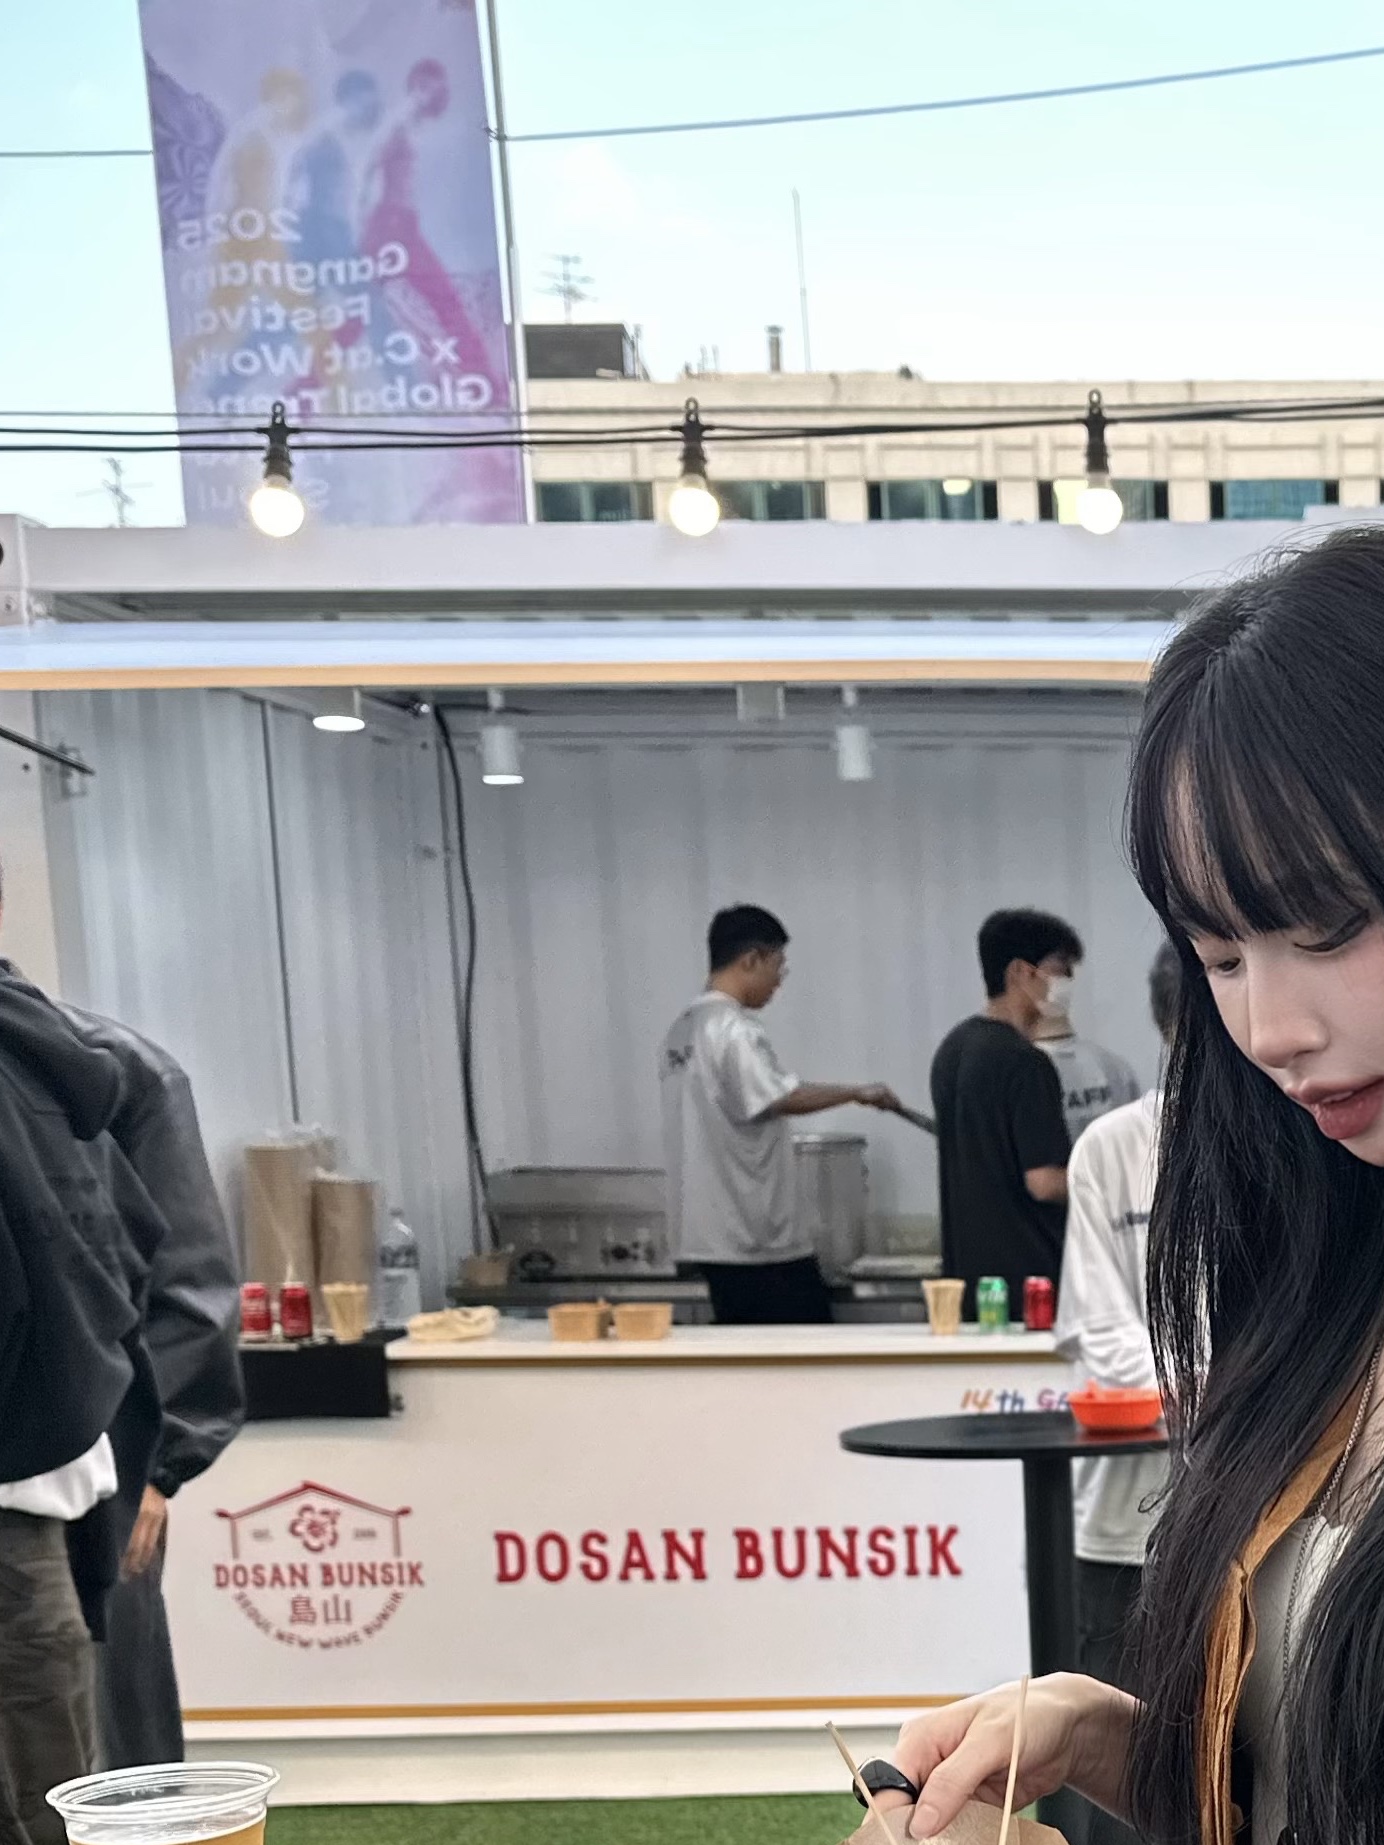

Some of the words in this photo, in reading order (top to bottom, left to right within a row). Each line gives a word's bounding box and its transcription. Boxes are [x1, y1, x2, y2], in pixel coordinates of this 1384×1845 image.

[213, 1562, 309, 1589] DOSAN
[319, 1560, 425, 1588] BUNSIK
[494, 1529, 708, 1584] DOSAN
[732, 1525, 963, 1580] BUNSIK
